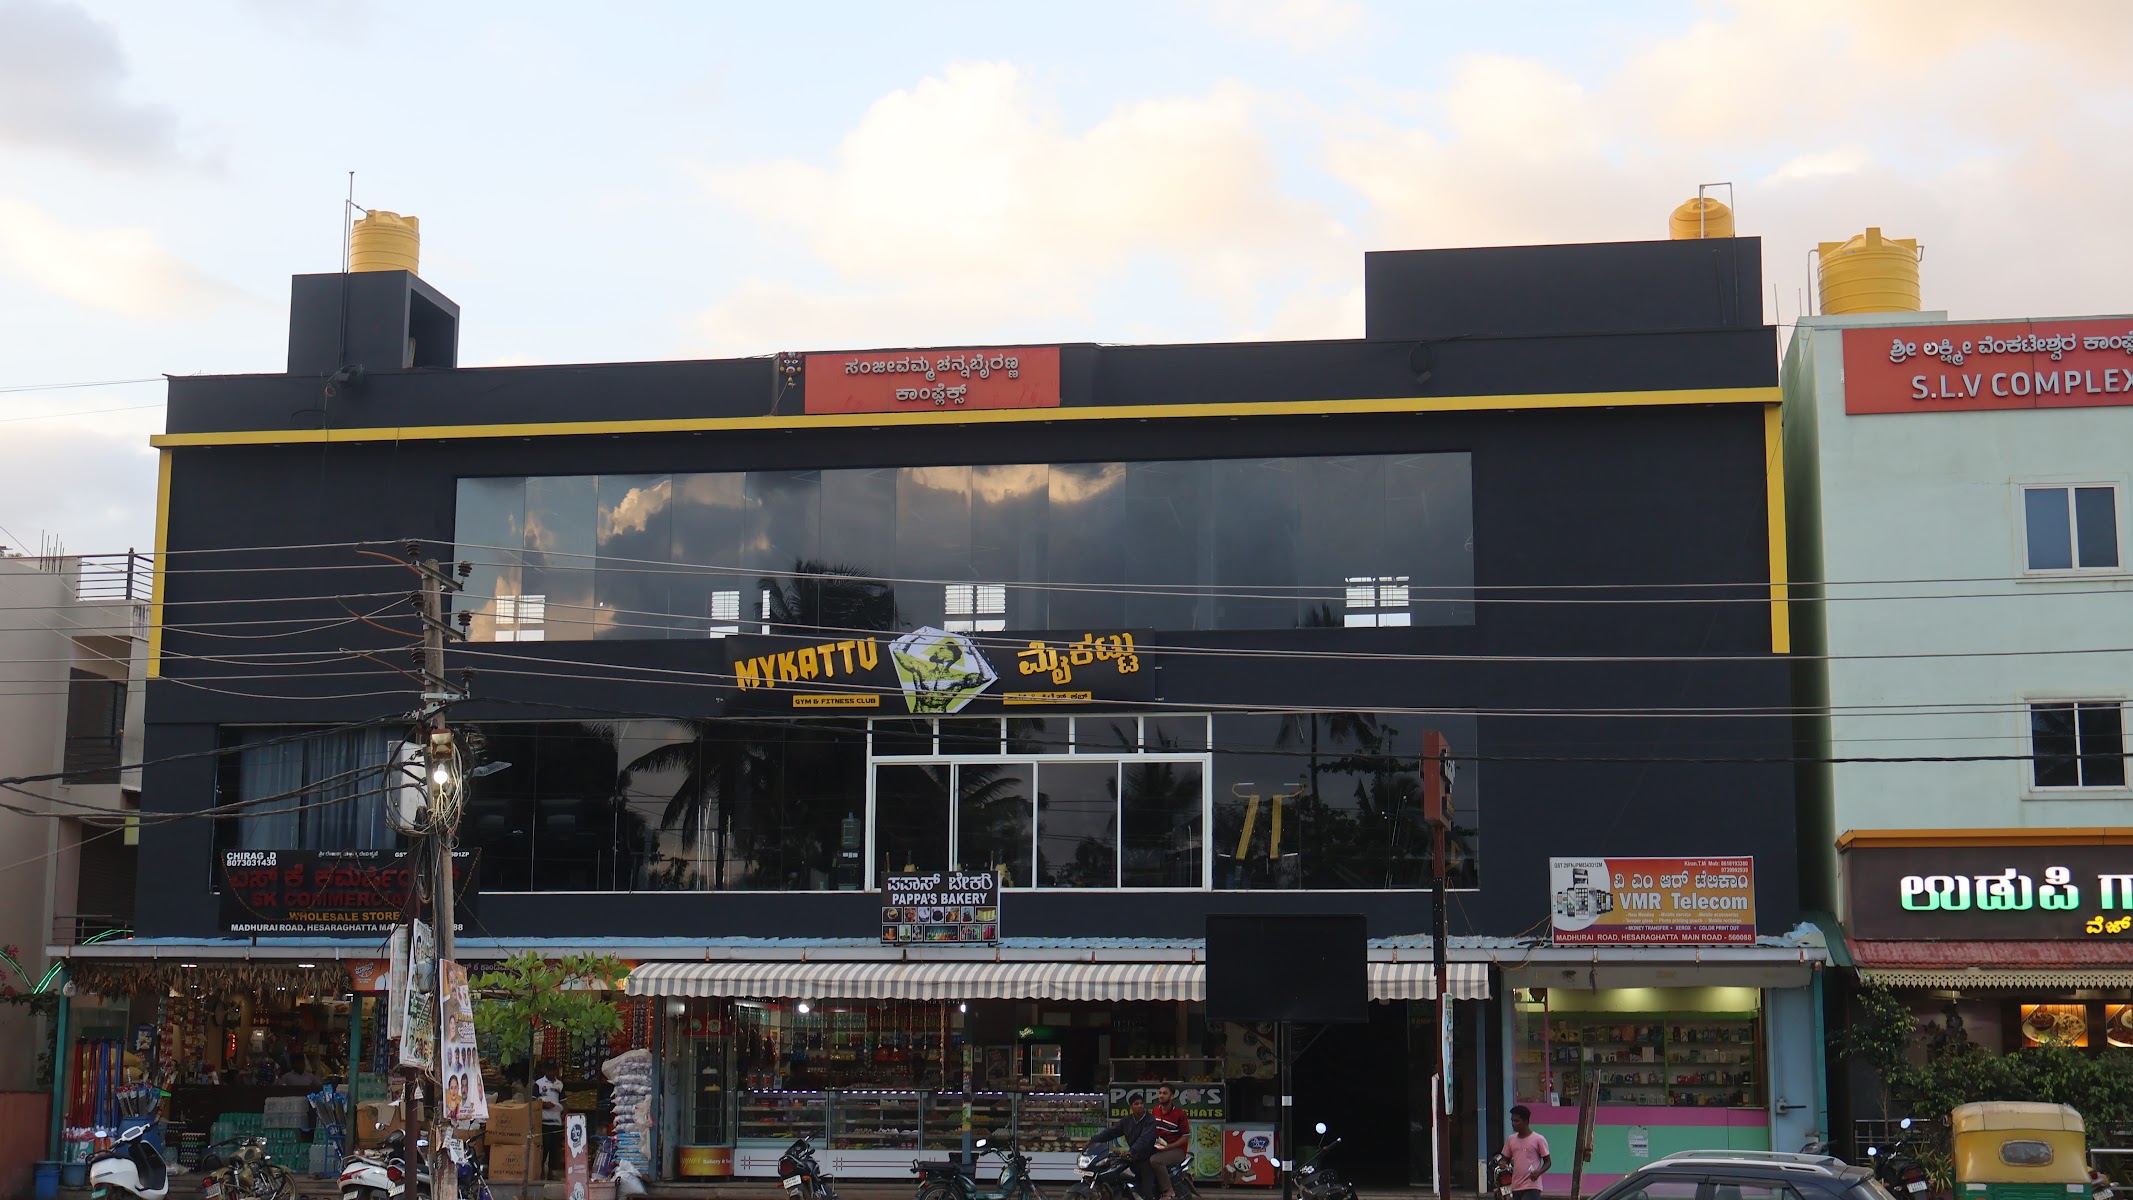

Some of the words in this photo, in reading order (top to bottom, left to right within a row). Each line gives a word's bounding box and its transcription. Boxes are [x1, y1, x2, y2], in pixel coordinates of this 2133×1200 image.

[1889, 338, 1917, 364] ಶ್ರೀ
[1978, 333, 2076, 361] ವೆಂಕಟೇಶ್ವರ
[845, 355, 936, 382] ಸಂಜೀವಮ್ಮ
[1912, 373, 1982, 399] S.L.V
[1991, 368, 2133, 397] COMPLEX
[734, 636, 879, 693] MYKATTU
[794, 697, 811, 706] GYM
[812, 697, 820, 706] &
[820, 697, 854, 706] FITNESS
[855, 697, 876, 705] CLUB
[226, 852, 264, 860] CHIRAG
[226, 859, 277, 867] 8073031430
[1613, 873, 1625, 889] ವಿ
[1631, 873, 1653, 889] ಎಂ
[1660, 870, 1689, 889] ಆರ್
[1900, 866, 2080, 911] ಉಡುಪಿ
[251, 892, 278, 907] SK
[892, 893, 937, 905] PAPPA'S
[941, 892, 987, 905] BAKERY
[1618, 892, 1661, 910] VMR
[1670, 892, 1748, 910] Telecom
[288, 911, 359, 922] WHOLESALE
[362, 911, 400, 921] STORE
[231, 924, 278, 932] MADHURAI
[279, 924, 306, 933] ROAD,
[307, 924, 378, 932] HESARAGHATTA
[1682, 933, 1700, 941] MAIN
[1701, 933, 1722, 941] ROAD
